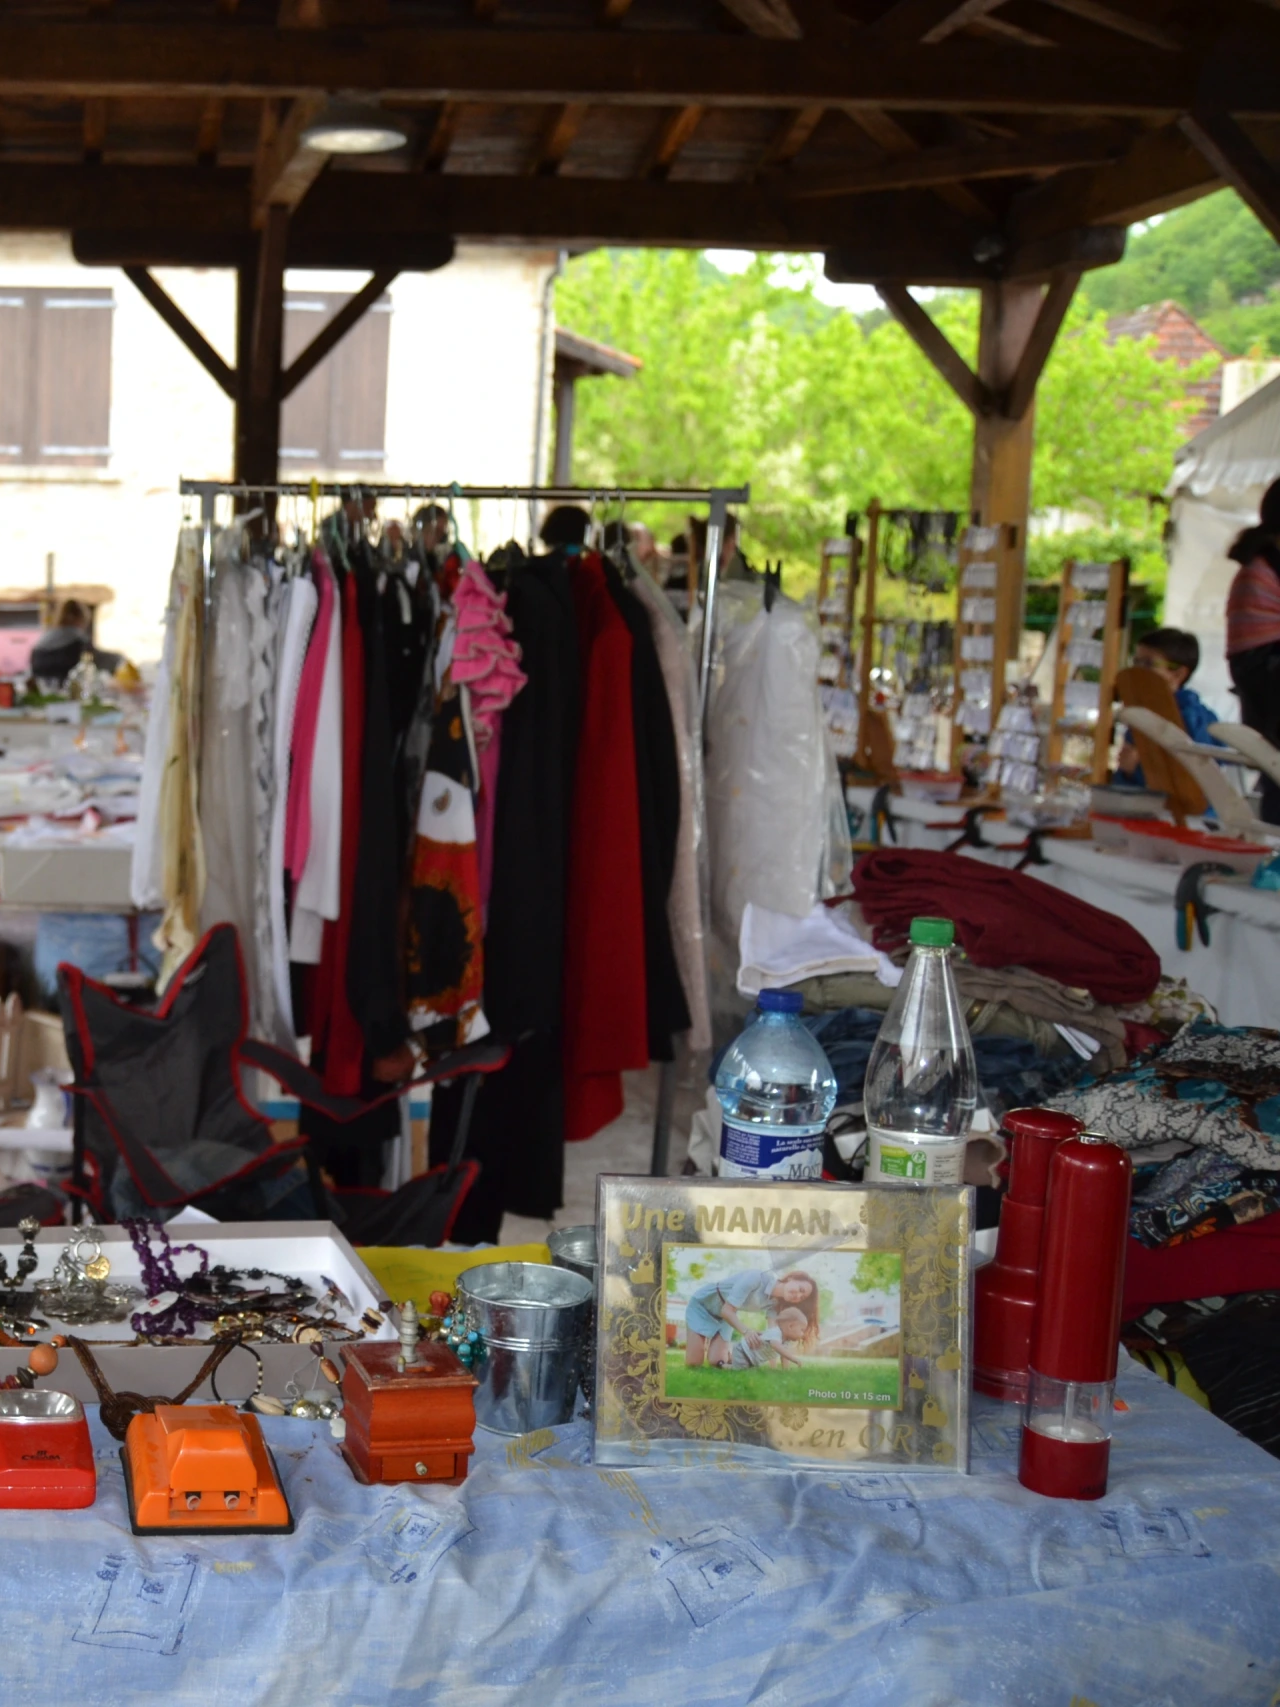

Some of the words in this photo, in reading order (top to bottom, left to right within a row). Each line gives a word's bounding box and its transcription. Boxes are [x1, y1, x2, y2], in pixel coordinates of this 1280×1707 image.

[621, 1202, 685, 1231] Une
[808, 1389, 837, 1399] Photo
[840, 1391, 851, 1400] 10
[863, 1392, 874, 1400] 15
[858, 1423, 920, 1457] OR
